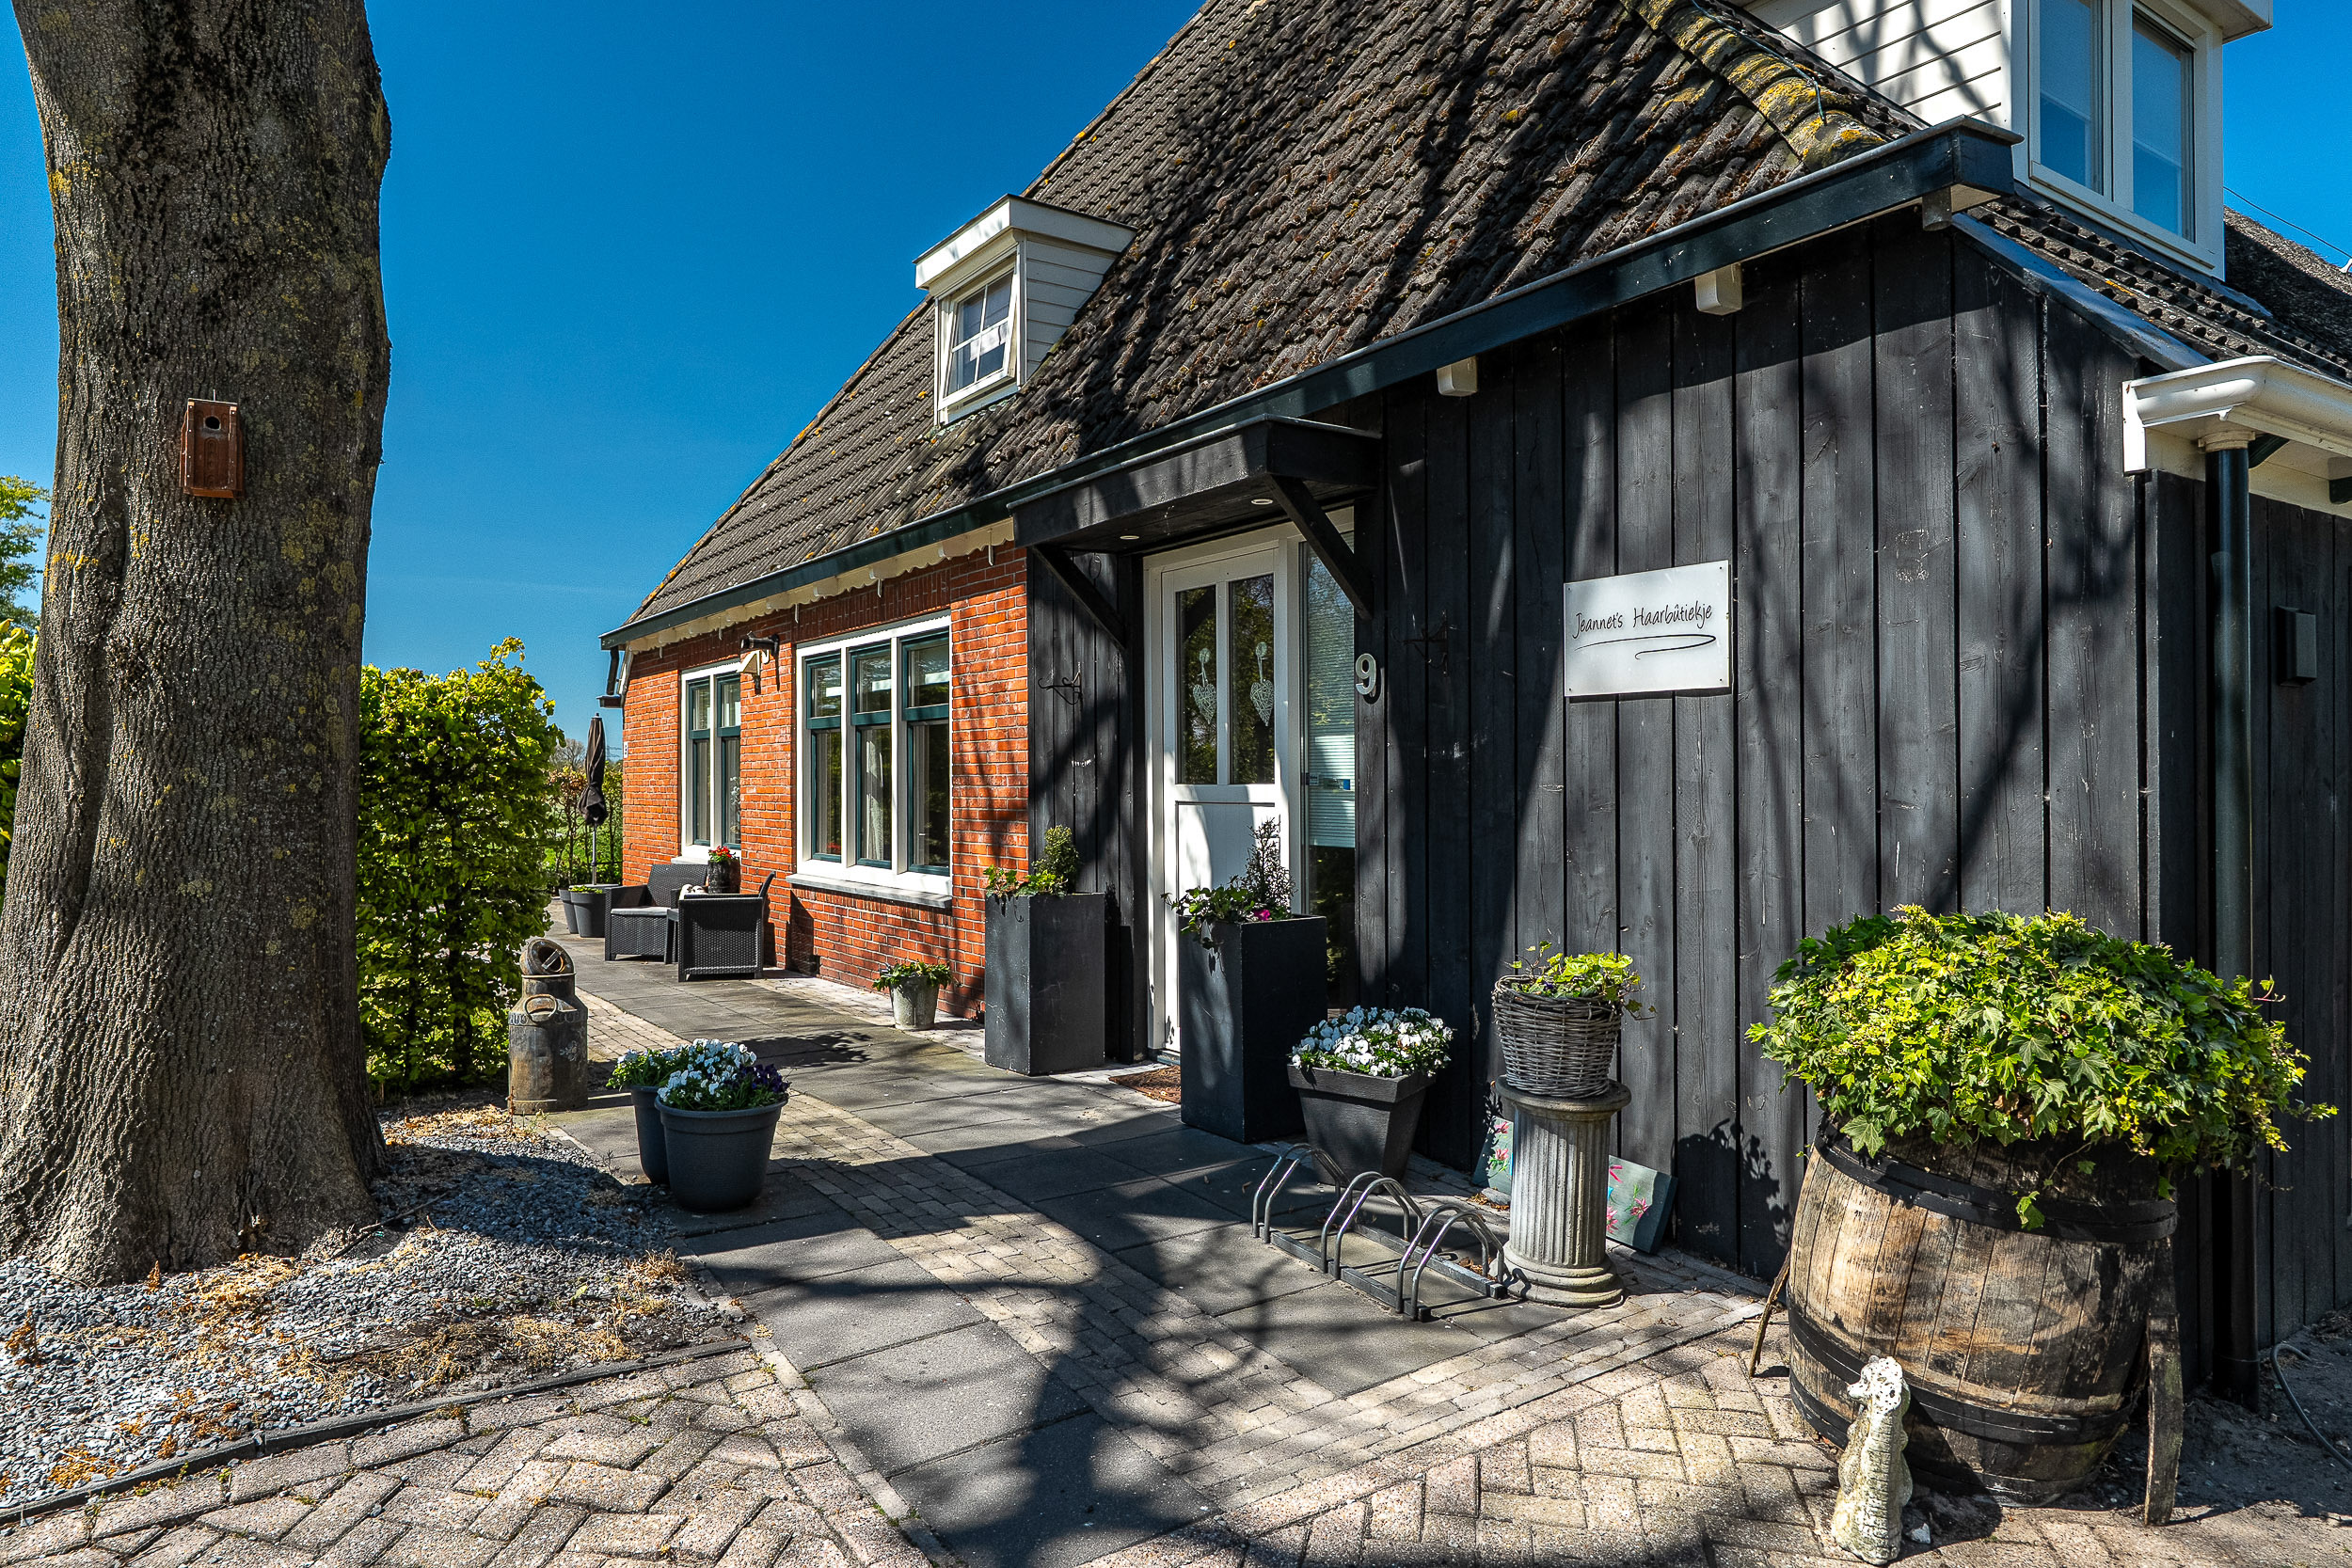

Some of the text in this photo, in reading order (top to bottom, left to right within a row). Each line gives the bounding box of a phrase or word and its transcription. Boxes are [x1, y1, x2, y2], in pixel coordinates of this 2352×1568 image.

[1572, 600, 1712, 640] Jeannet's Haarbûtiekje
[1355, 653, 1376, 695] 9
